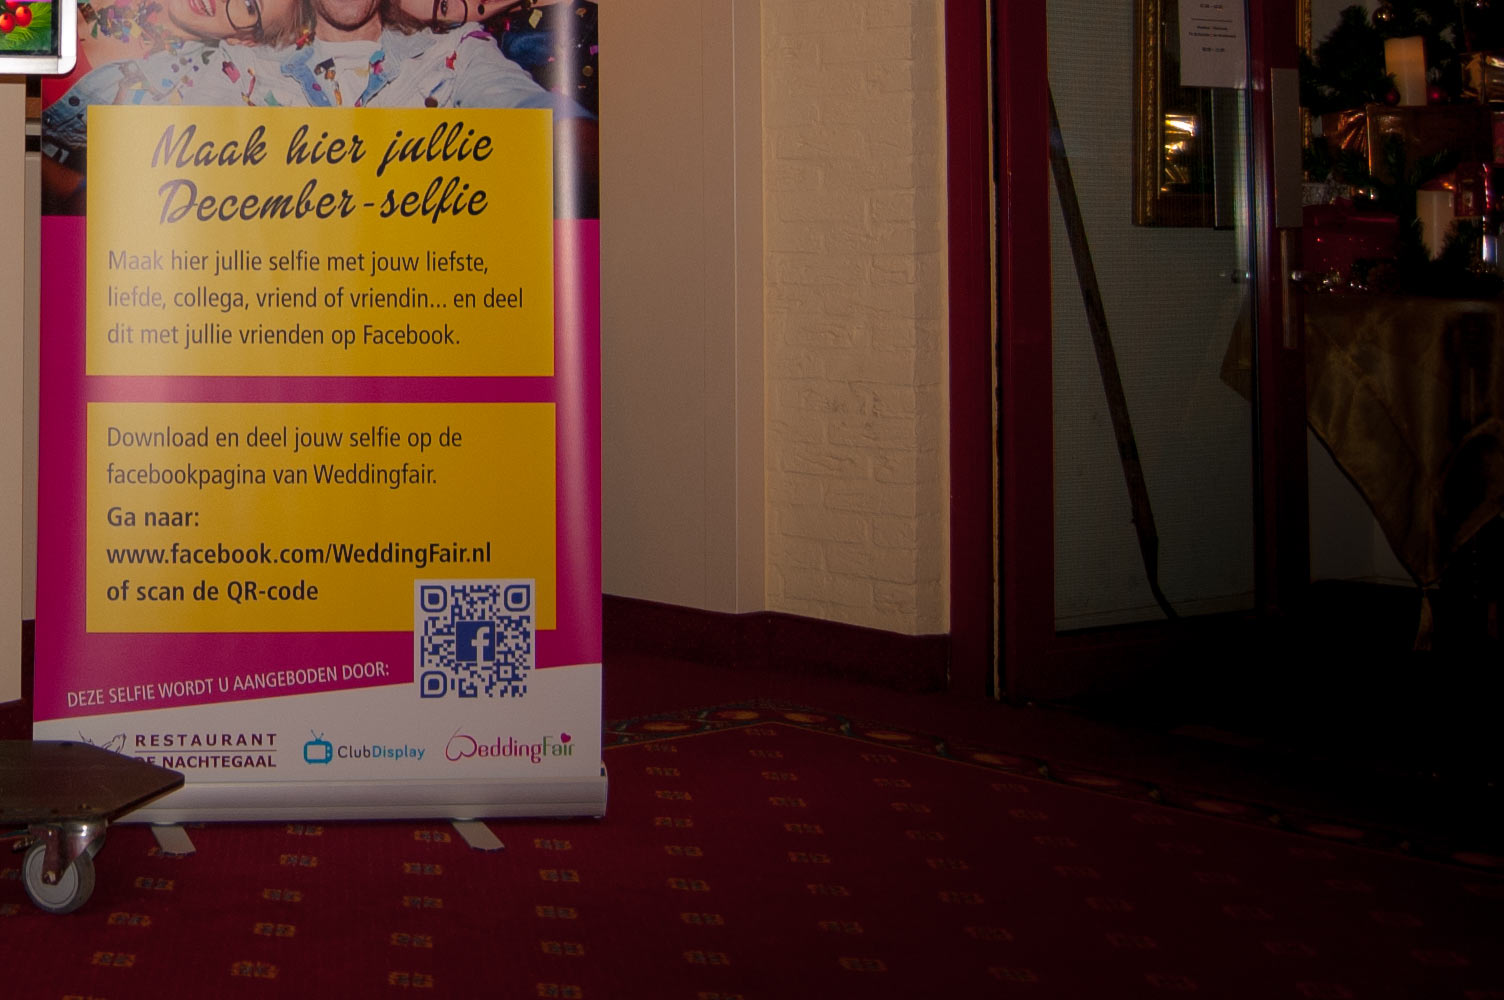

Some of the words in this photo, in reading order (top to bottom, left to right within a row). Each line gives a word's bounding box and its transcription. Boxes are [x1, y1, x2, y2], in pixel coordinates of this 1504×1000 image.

[151, 123, 267, 169] Maak
[286, 124, 366, 166] hier
[376, 121, 494, 177] jullie
[107, 250, 163, 272] Maak
[171, 250, 209, 272] hier
[213, 250, 263, 277] jullie
[269, 250, 321, 272] selfie
[327, 253, 365, 272] met
[369, 251, 420, 278] jouw
[425, 250, 489, 275] liefste,
[107, 286, 166, 311] liefde,
[173, 287, 249, 315] collega,
[255, 286, 318, 309] vriend
[324, 286, 346, 309] of
[349, 287, 447, 309] vriendin...
[453, 292, 477, 309] en
[483, 287, 523, 309] deel
[107, 322, 134, 345] dit
[140, 325, 179, 345] met
[184, 322, 233, 350] jullie
[239, 323, 325, 345] vrienden
[331, 329, 357, 350] op
[363, 323, 461, 346] Facebook.
[106, 426, 209, 448] Download
[215, 432, 240, 448] en
[246, 426, 288, 448] deel
[292, 427, 344, 454] jouw
[349, 426, 401, 448] selfie
[407, 432, 433, 454] op
[438, 427, 463, 448] de
[106, 463, 267, 490] facebookpagina
[272, 469, 309, 485] van
[313, 463, 437, 490] Weddingfair.
[106, 506, 137, 528] Ga
[143, 511, 200, 528] naar:
[106, 542, 492, 569] www.facebook.com/WeddingFair.nl
[106, 580, 130, 602] of
[136, 585, 185, 602] scan
[192, 580, 220, 602] de
[226, 580, 319, 604] QR-code
[67, 690, 105, 708] DEZE
[108, 685, 155, 704] SELFIE
[158, 679, 213, 700] WORDT
[217, 678, 229, 694] U
[232, 667, 338, 692] AANGEBODEN
[342, 661, 390, 682] DOOR:
[135, 733, 277, 747] RESTAURANT
[337, 745, 426, 761] ClubDisplay
[445, 727, 575, 764] WeddingFair
[162, 755, 277, 768] NACHTEGAAL
